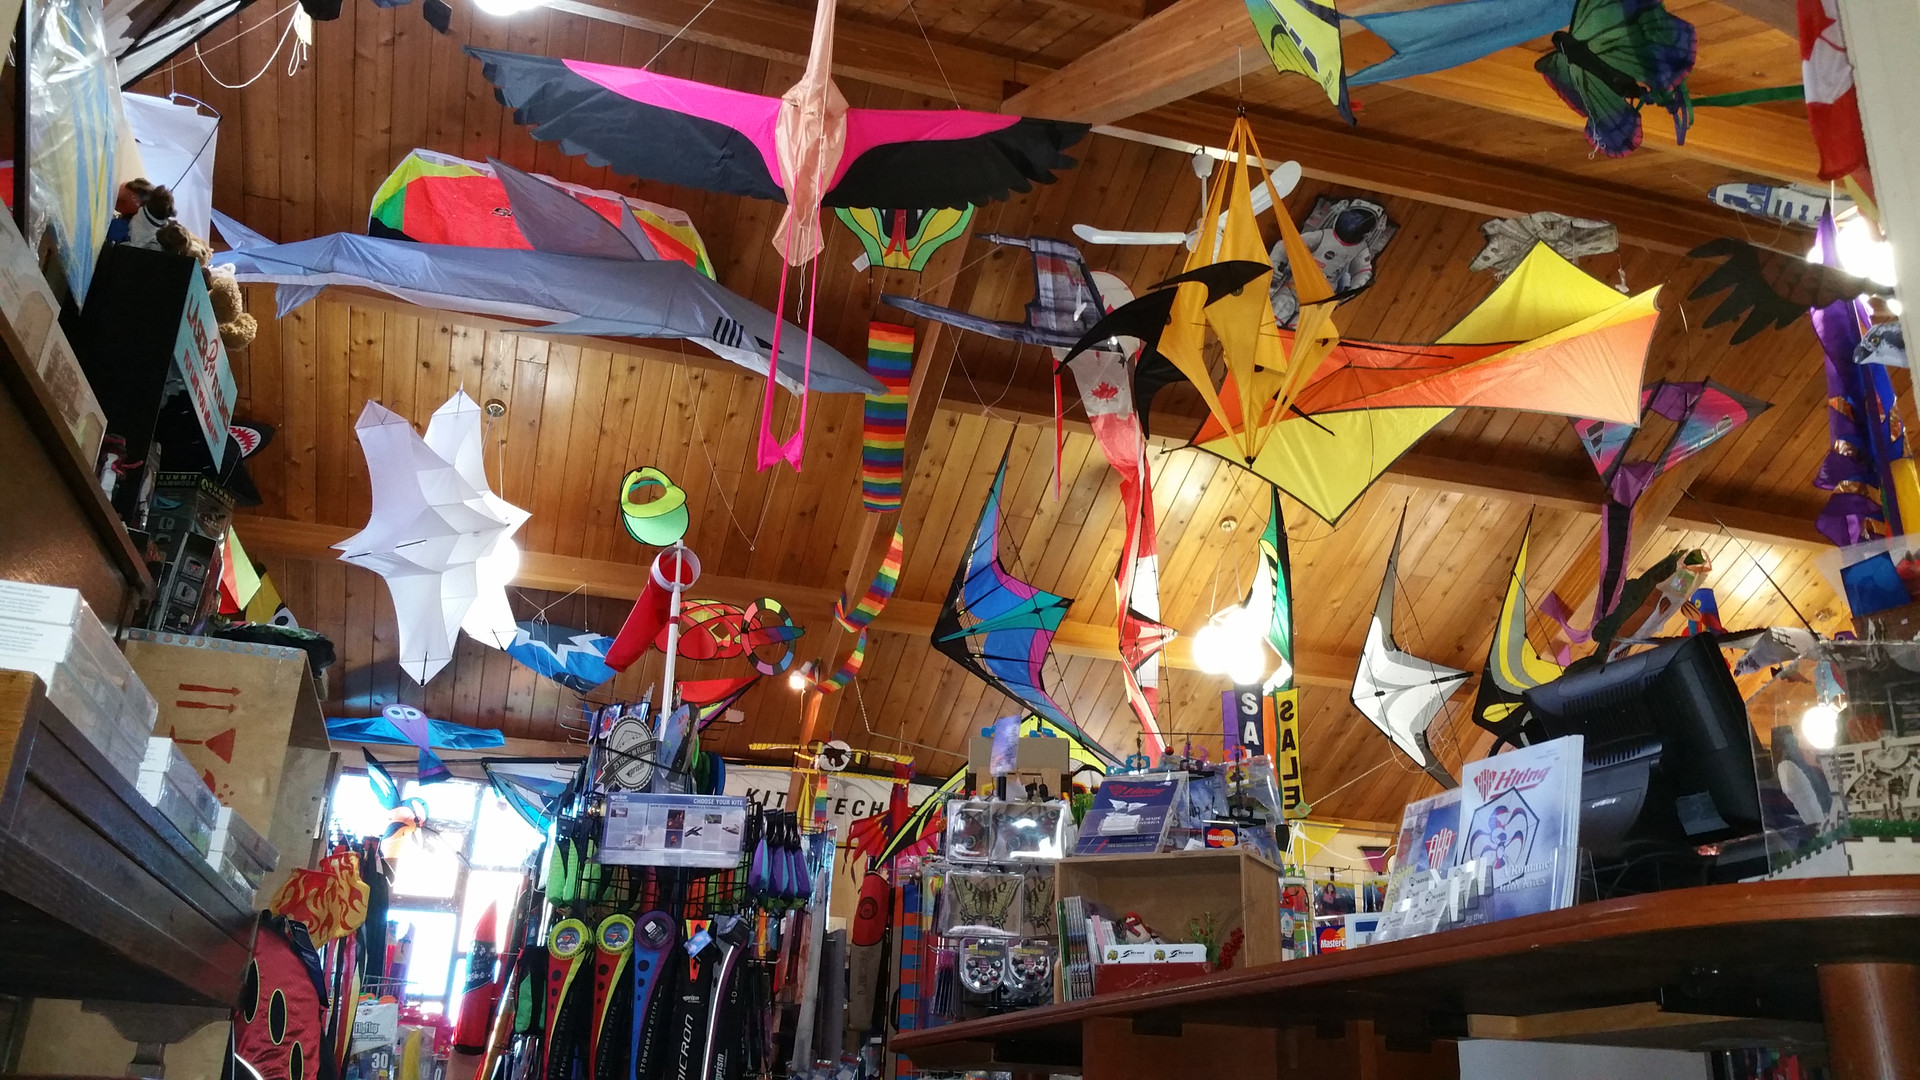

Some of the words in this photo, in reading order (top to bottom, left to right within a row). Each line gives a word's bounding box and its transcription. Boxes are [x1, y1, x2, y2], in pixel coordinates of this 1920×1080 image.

[1241, 692, 1260, 758] SA
[745, 788, 788, 808] KIT
[825, 797, 885, 817] ECH
[1207, 833, 1236, 842] MasterCard
[1427, 827, 1456, 870] AKA
[1320, 937, 1346, 949] MasterC
[639, 1028, 653, 1074] STOWAWAY
[649, 1001, 658, 1025] DELTA
[371, 1052, 389, 1069] 30
